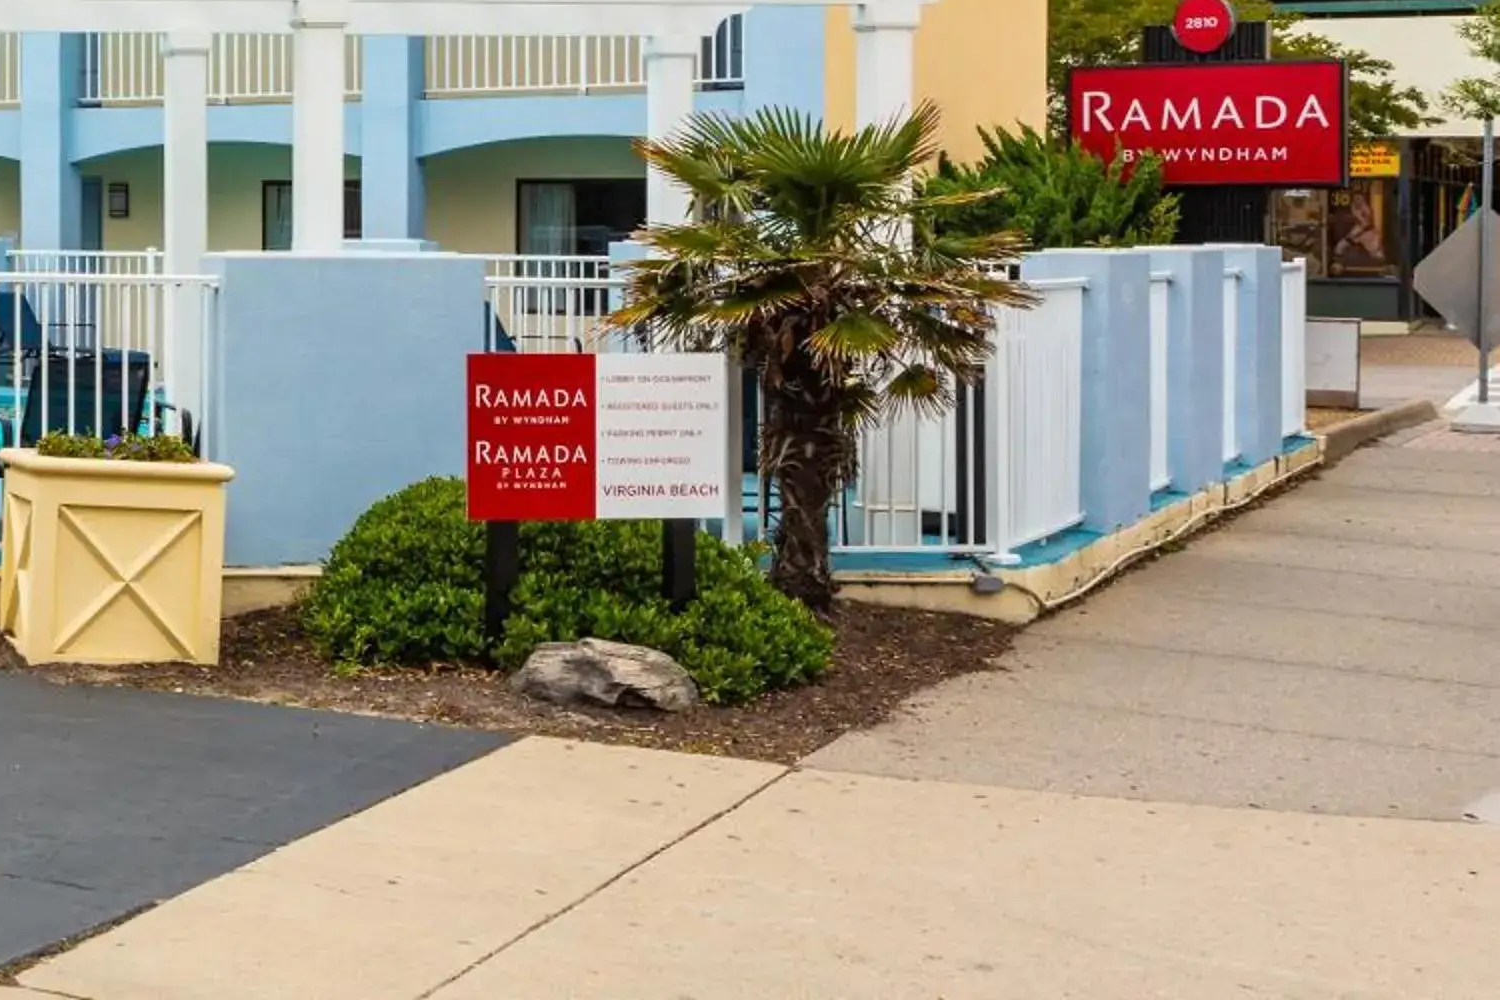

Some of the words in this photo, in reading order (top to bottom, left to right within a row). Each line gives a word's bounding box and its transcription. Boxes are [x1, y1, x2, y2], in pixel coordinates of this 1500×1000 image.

[1184, 16, 1219, 29] 2810
[1082, 90, 1329, 133] RAMADA
[1161, 147, 1288, 162] WYNDHAM
[475, 383, 588, 409] RAMADA
[475, 440, 588, 465] RAMADA
[501, 467, 563, 479] PLAZA
[603, 484, 666, 498] VIRGINIA
[669, 483, 719, 498] BEACH
